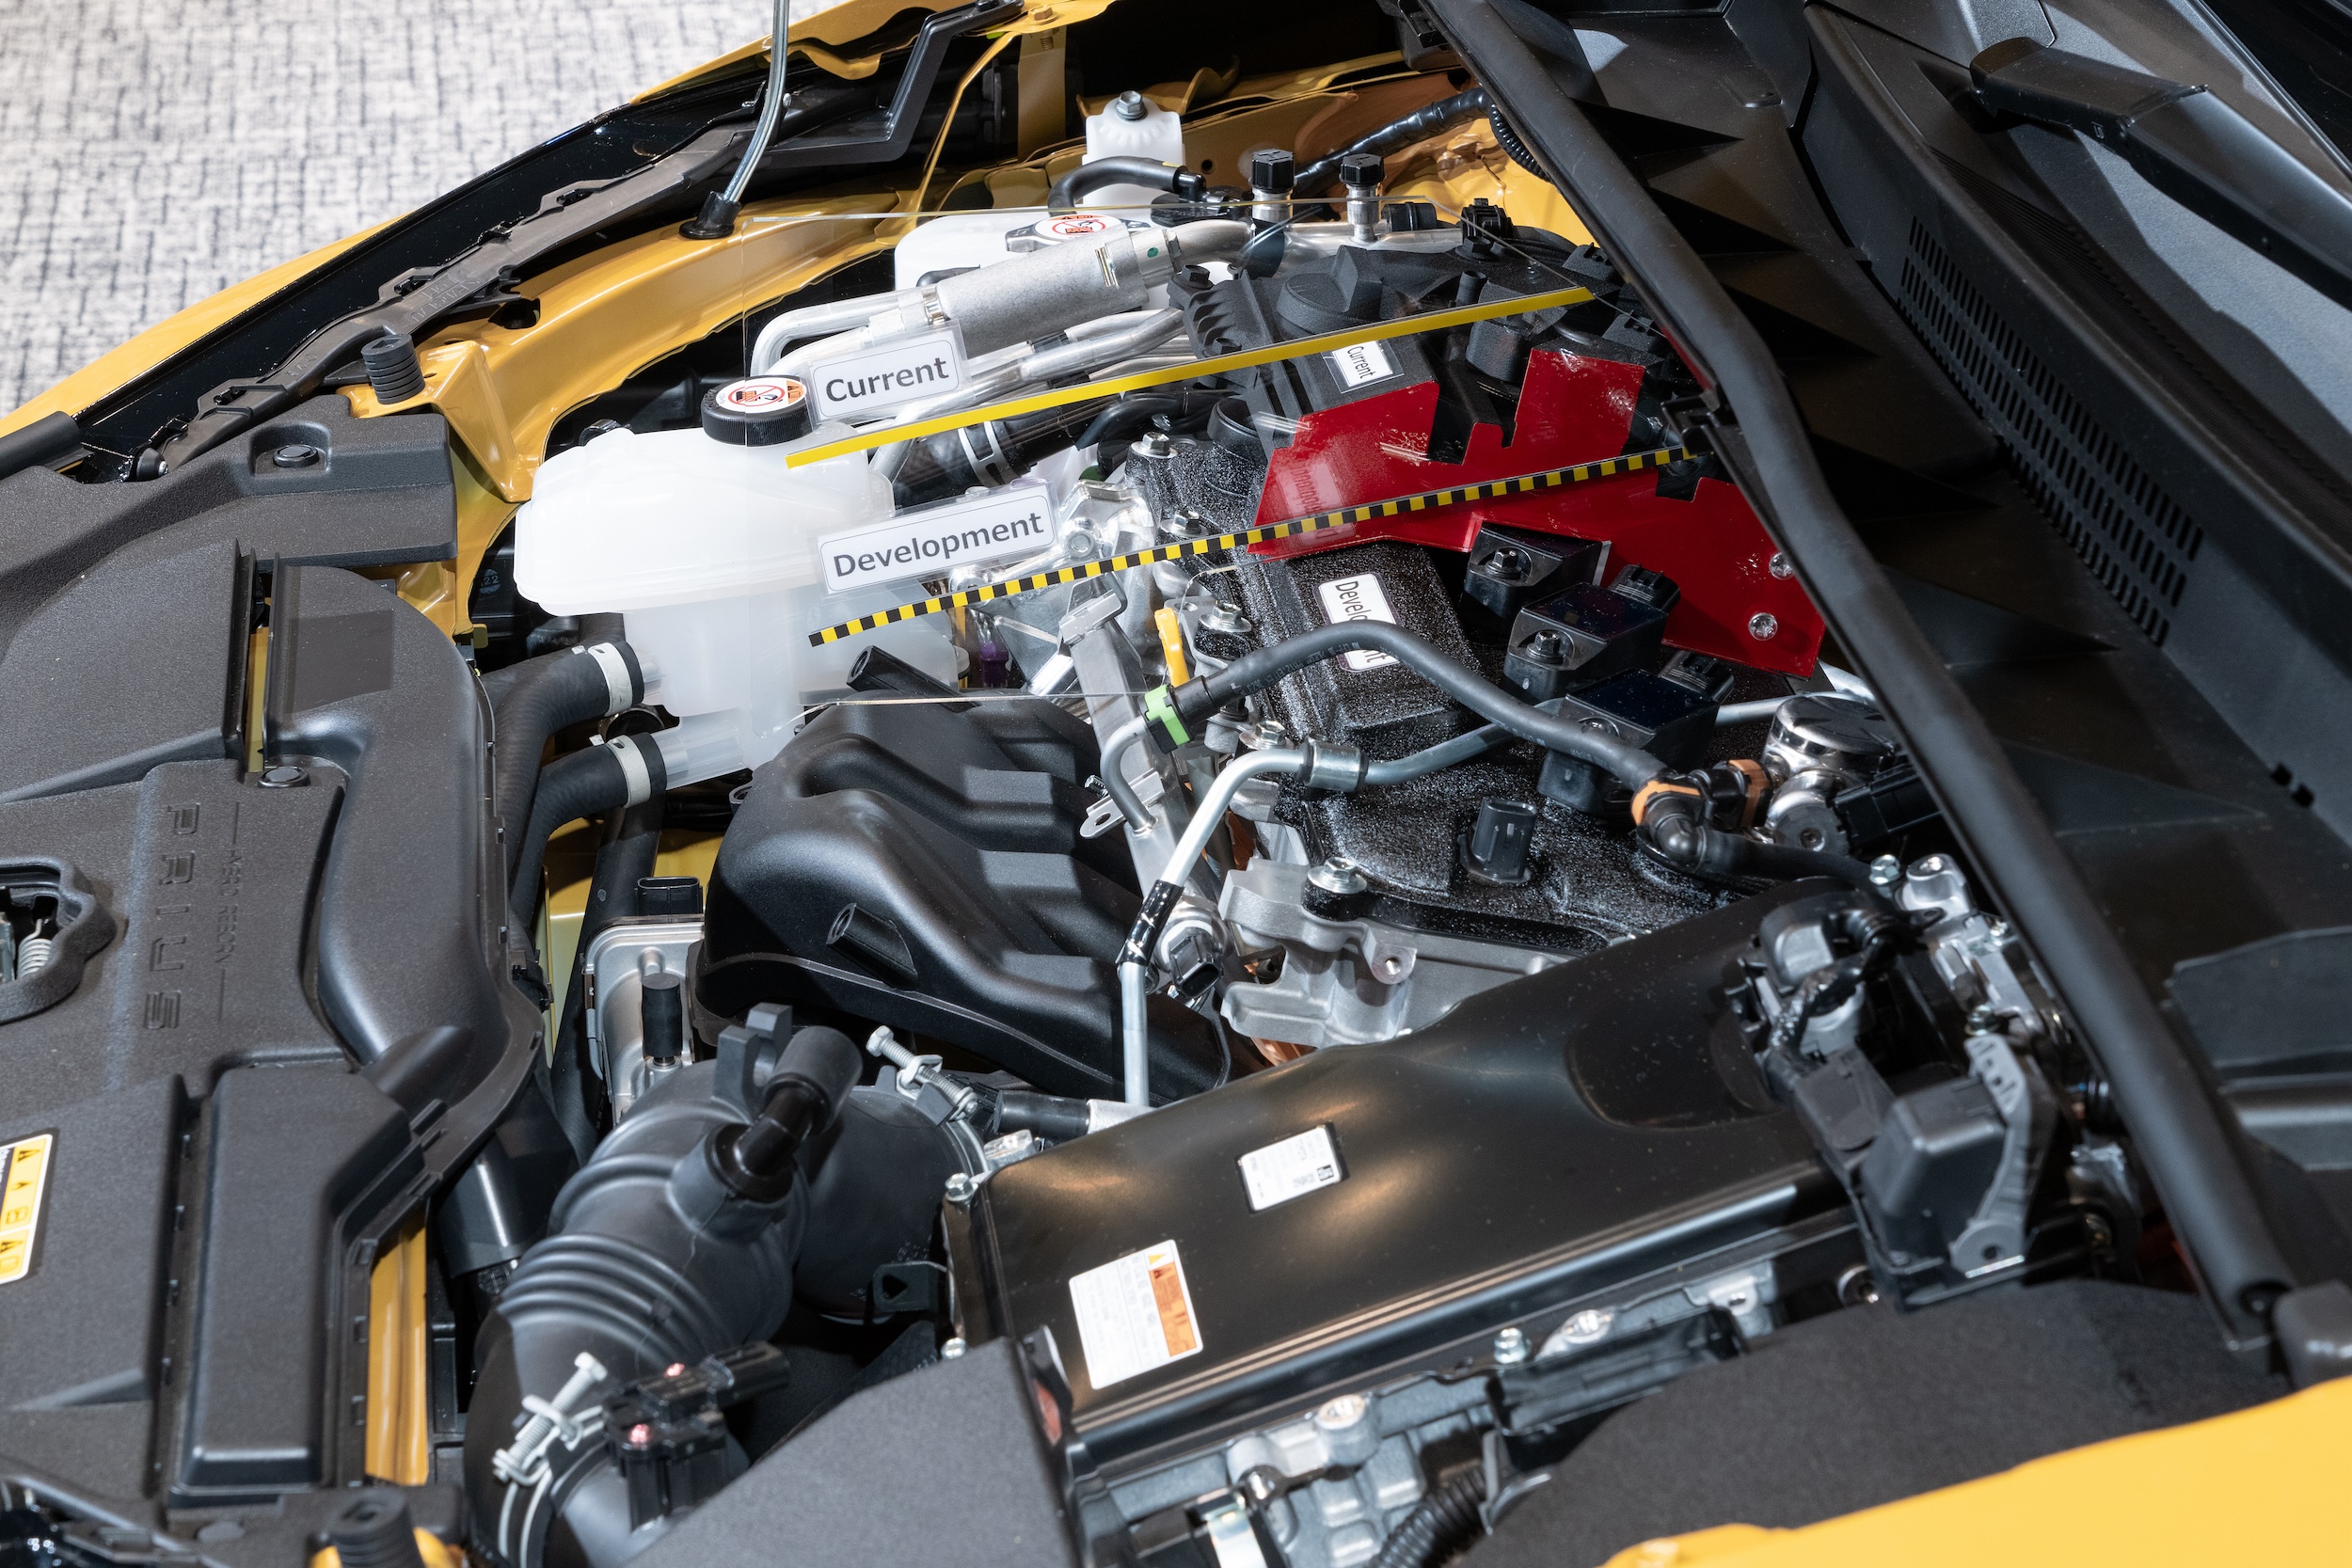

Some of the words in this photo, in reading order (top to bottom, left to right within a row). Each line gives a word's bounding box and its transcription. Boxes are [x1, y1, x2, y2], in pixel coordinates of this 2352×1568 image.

[825, 356, 949, 403] Current
[1347, 346, 1375, 379] Current
[833, 512, 1044, 578] Development
[222, 848, 242, 896] HYBRID
[144, 802, 199, 1029] PRIUS
[214, 902, 237, 964] REBORN
